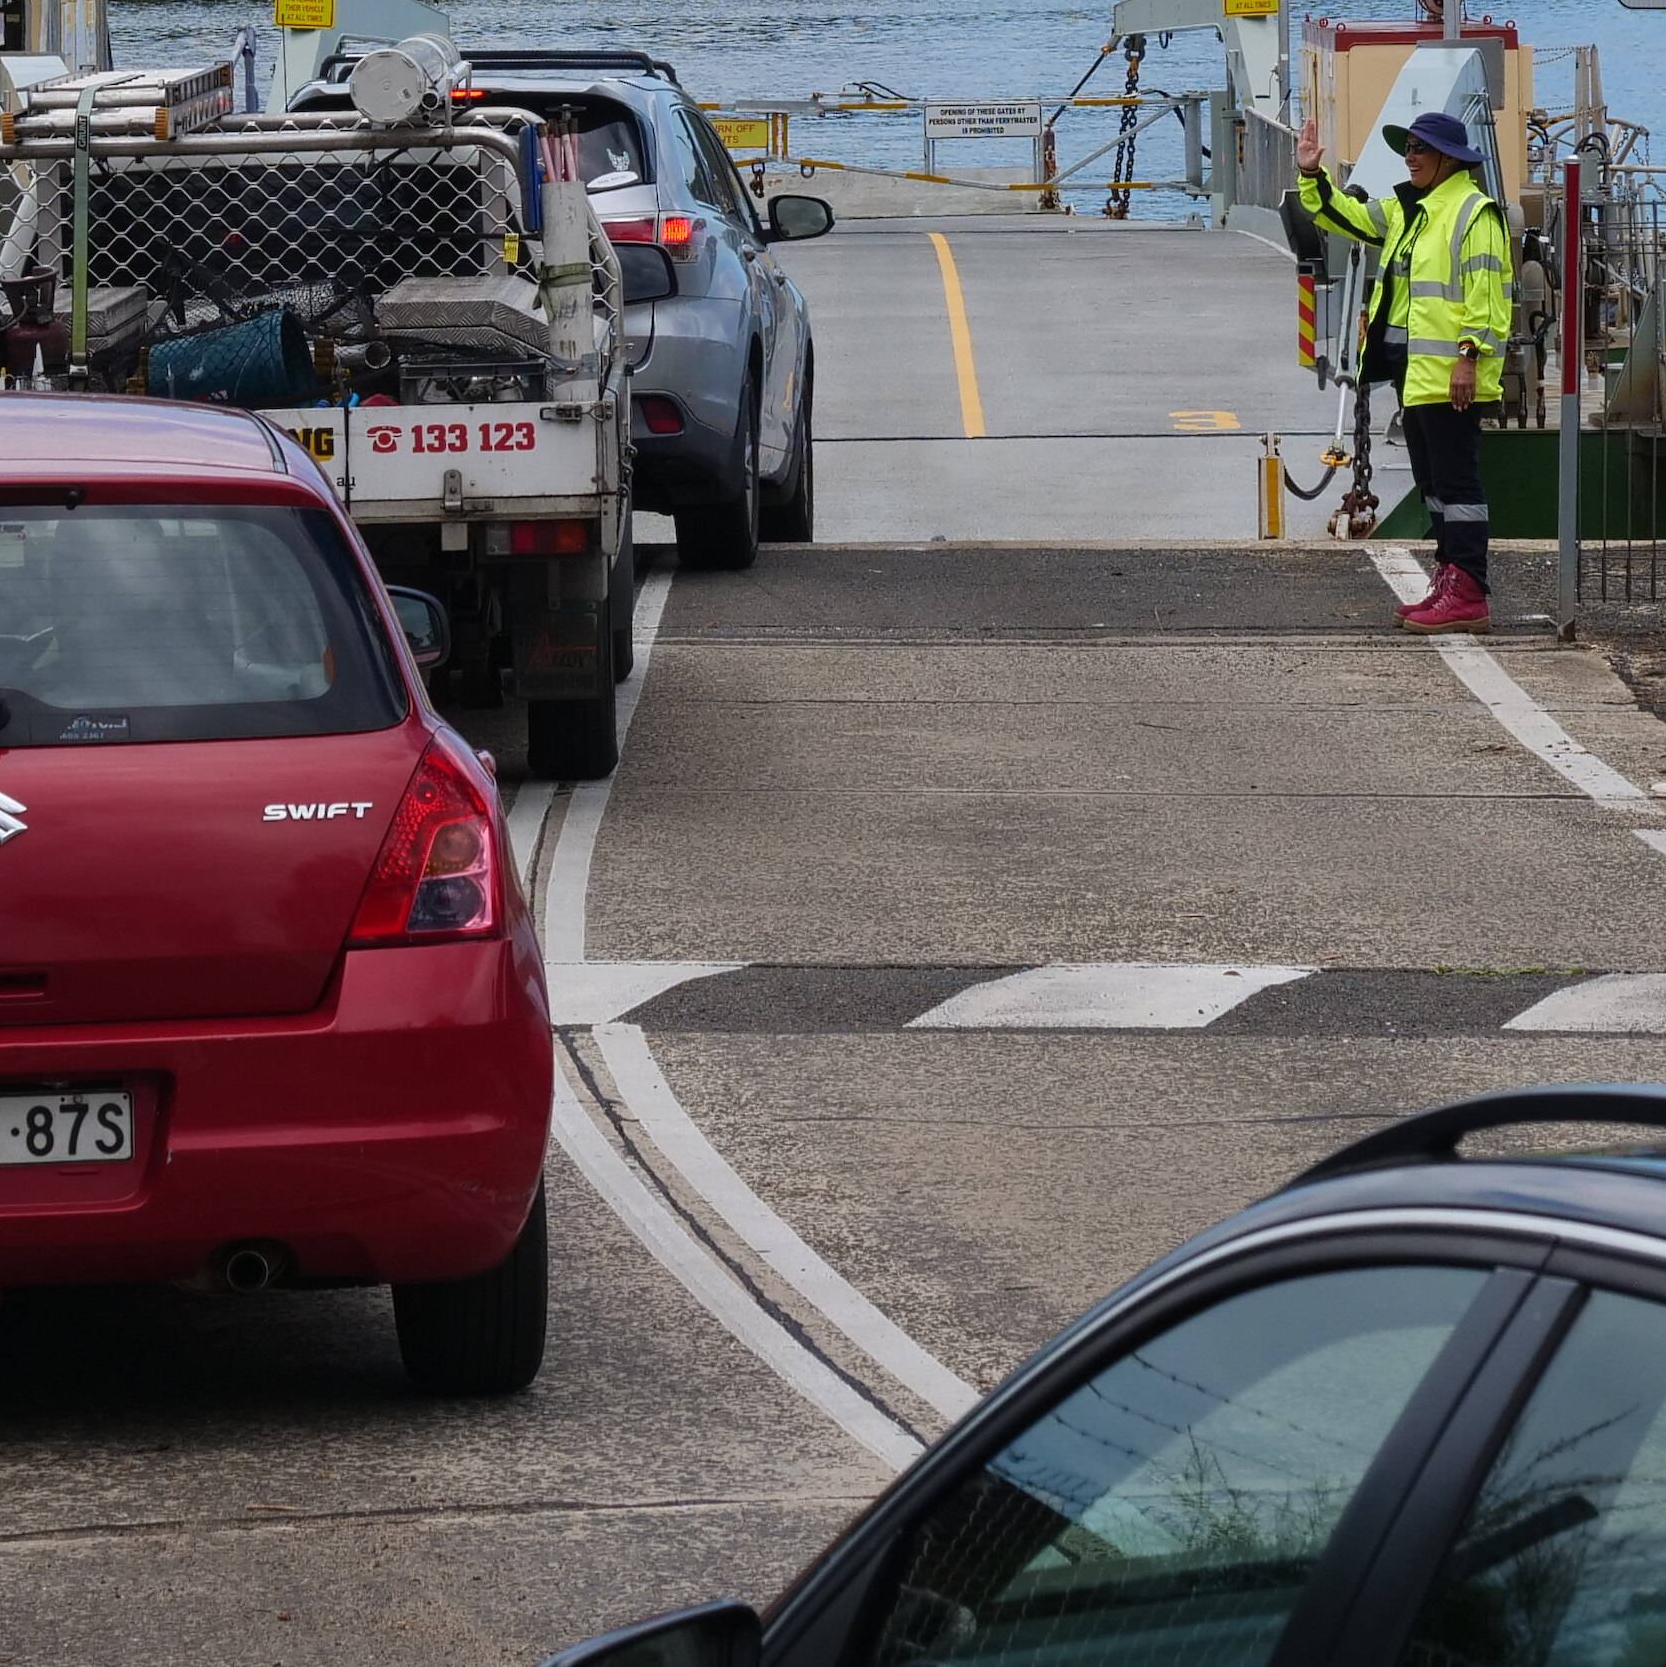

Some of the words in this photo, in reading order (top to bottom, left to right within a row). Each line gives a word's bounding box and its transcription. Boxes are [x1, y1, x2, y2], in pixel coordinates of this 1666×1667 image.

[77, 116, 87, 147] GRUNT
[737, 124, 755, 133] OFF
[1169, 410, 1241, 430] 3
[411, 424, 468, 453] 133
[480, 422, 535, 451] 123
[262, 802, 373, 822] SWIFT
